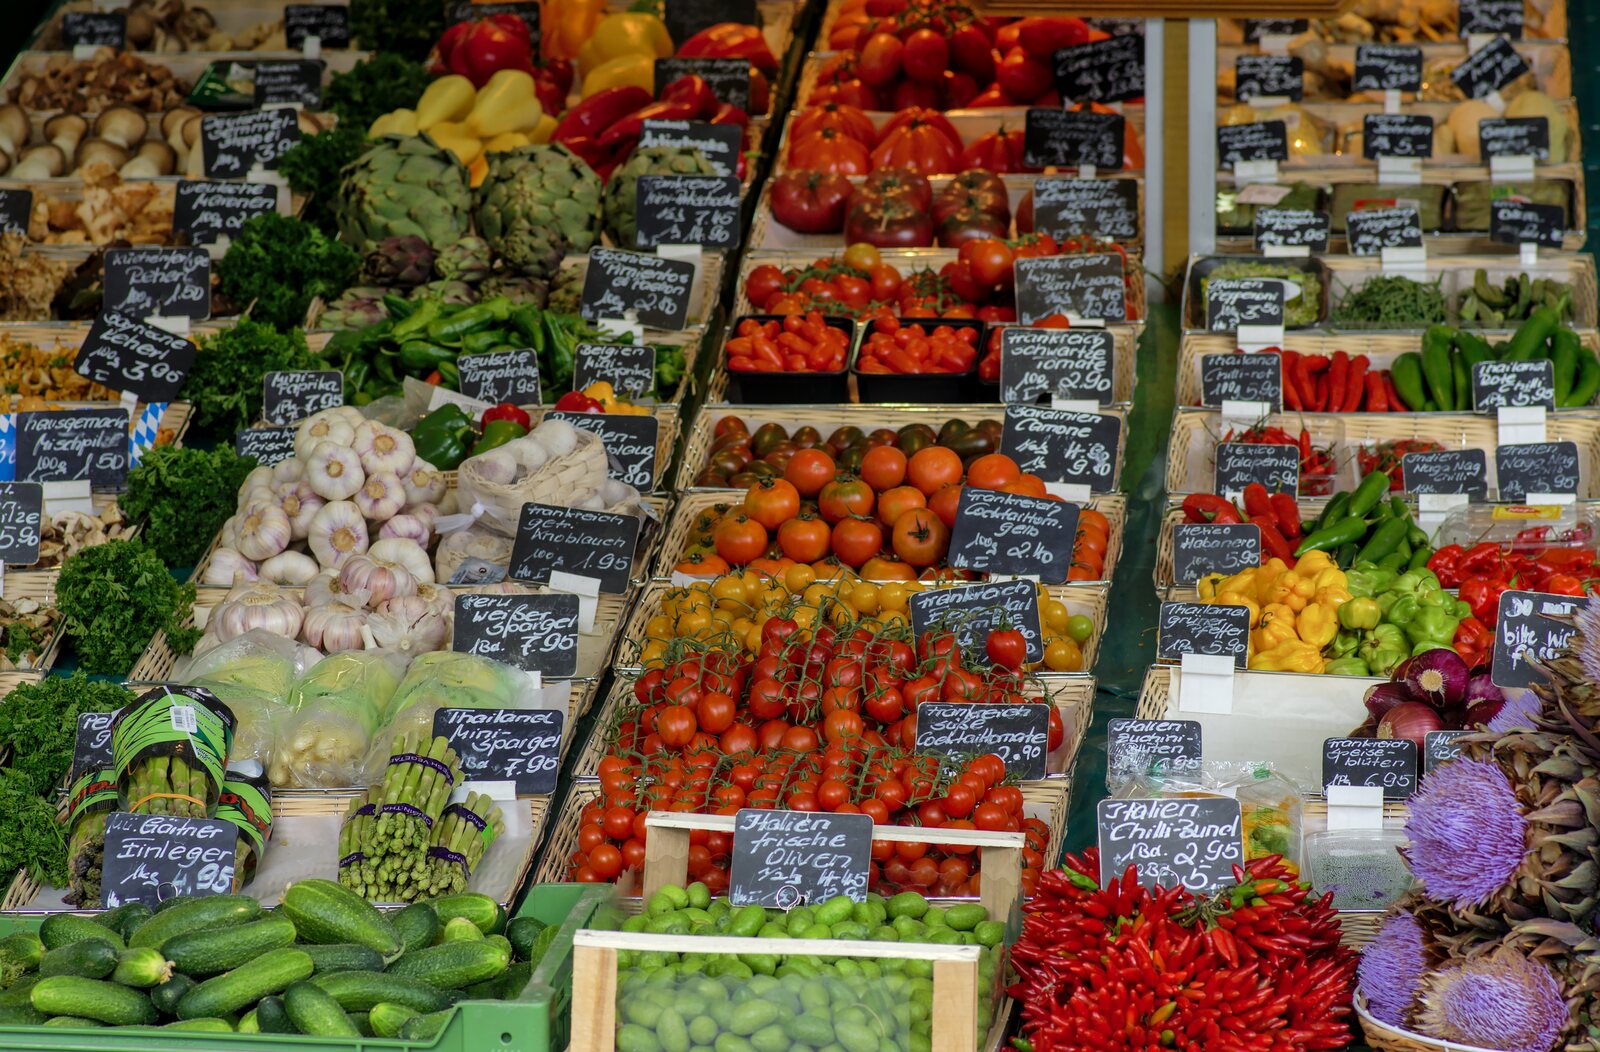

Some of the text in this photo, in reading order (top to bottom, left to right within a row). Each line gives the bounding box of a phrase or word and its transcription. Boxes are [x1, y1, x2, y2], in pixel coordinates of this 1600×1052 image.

[458, 352, 530, 370] Deutsche
[580, 346, 646, 363] Belgien
[967, 489, 1062, 516] Frankreich
[528, 504, 626, 526] Frankreich
[532, 530, 627, 549] Knoblauch
[1180, 536, 1257, 550] Habanero
[572, 550, 632, 571] 1.95
[461, 594, 512, 610] Peru
[1164, 603, 1248, 617] Thailand
[520, 633, 579, 658] 7.95
[447, 709, 556, 726] Thailand
[450, 724, 512, 742] Mini-
[1326, 739, 1410, 751] Frankreich
[504, 756, 559, 779] 7.95
[1105, 800, 1200, 822] Italien
[739, 812, 832, 833] Italien
[1110, 814, 1240, 842] Chilli-Bund
[751, 831, 848, 855] frische
[1172, 840, 1242, 867] 2.95
[765, 847, 853, 869] Oliven
